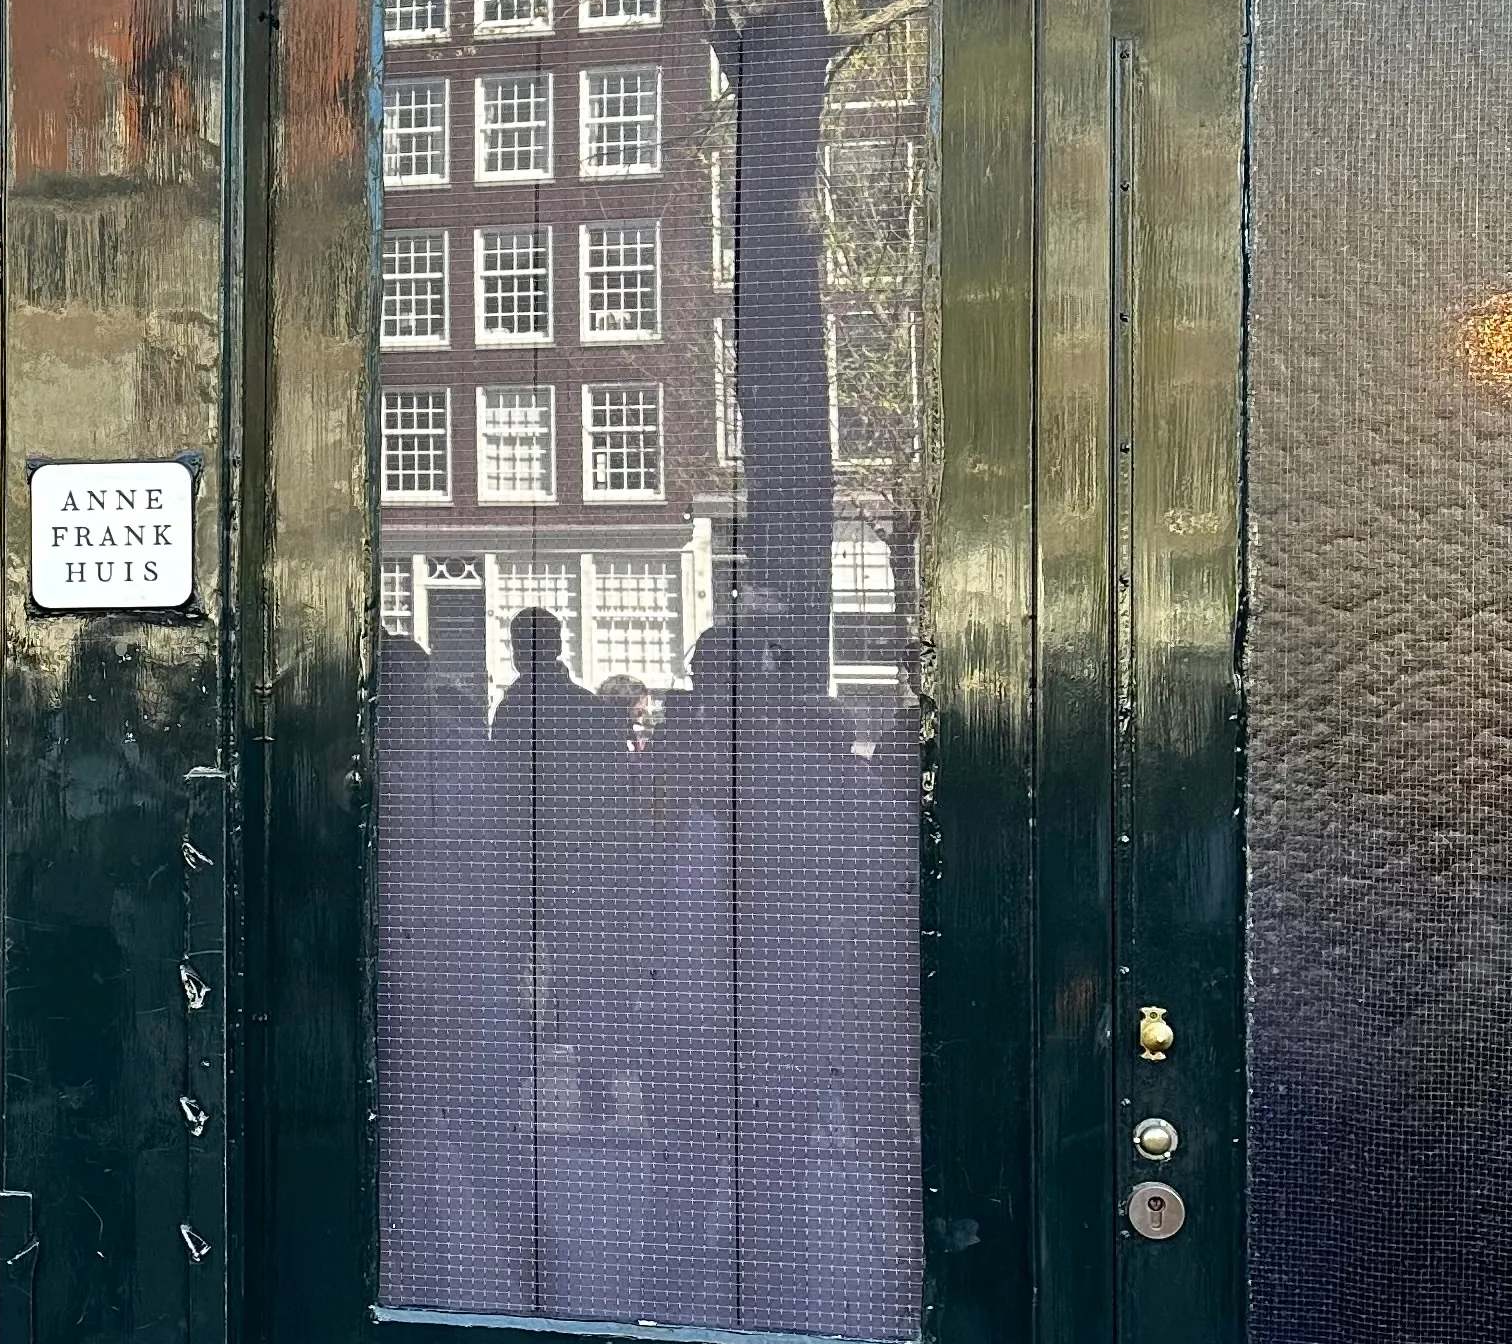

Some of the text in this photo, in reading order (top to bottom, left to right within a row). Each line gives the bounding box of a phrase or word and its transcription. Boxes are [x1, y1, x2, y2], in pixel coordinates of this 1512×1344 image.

[60, 488, 163, 511] ANNE
[51, 524, 172, 547] FRANK
[65, 560, 158, 583] HUIS
